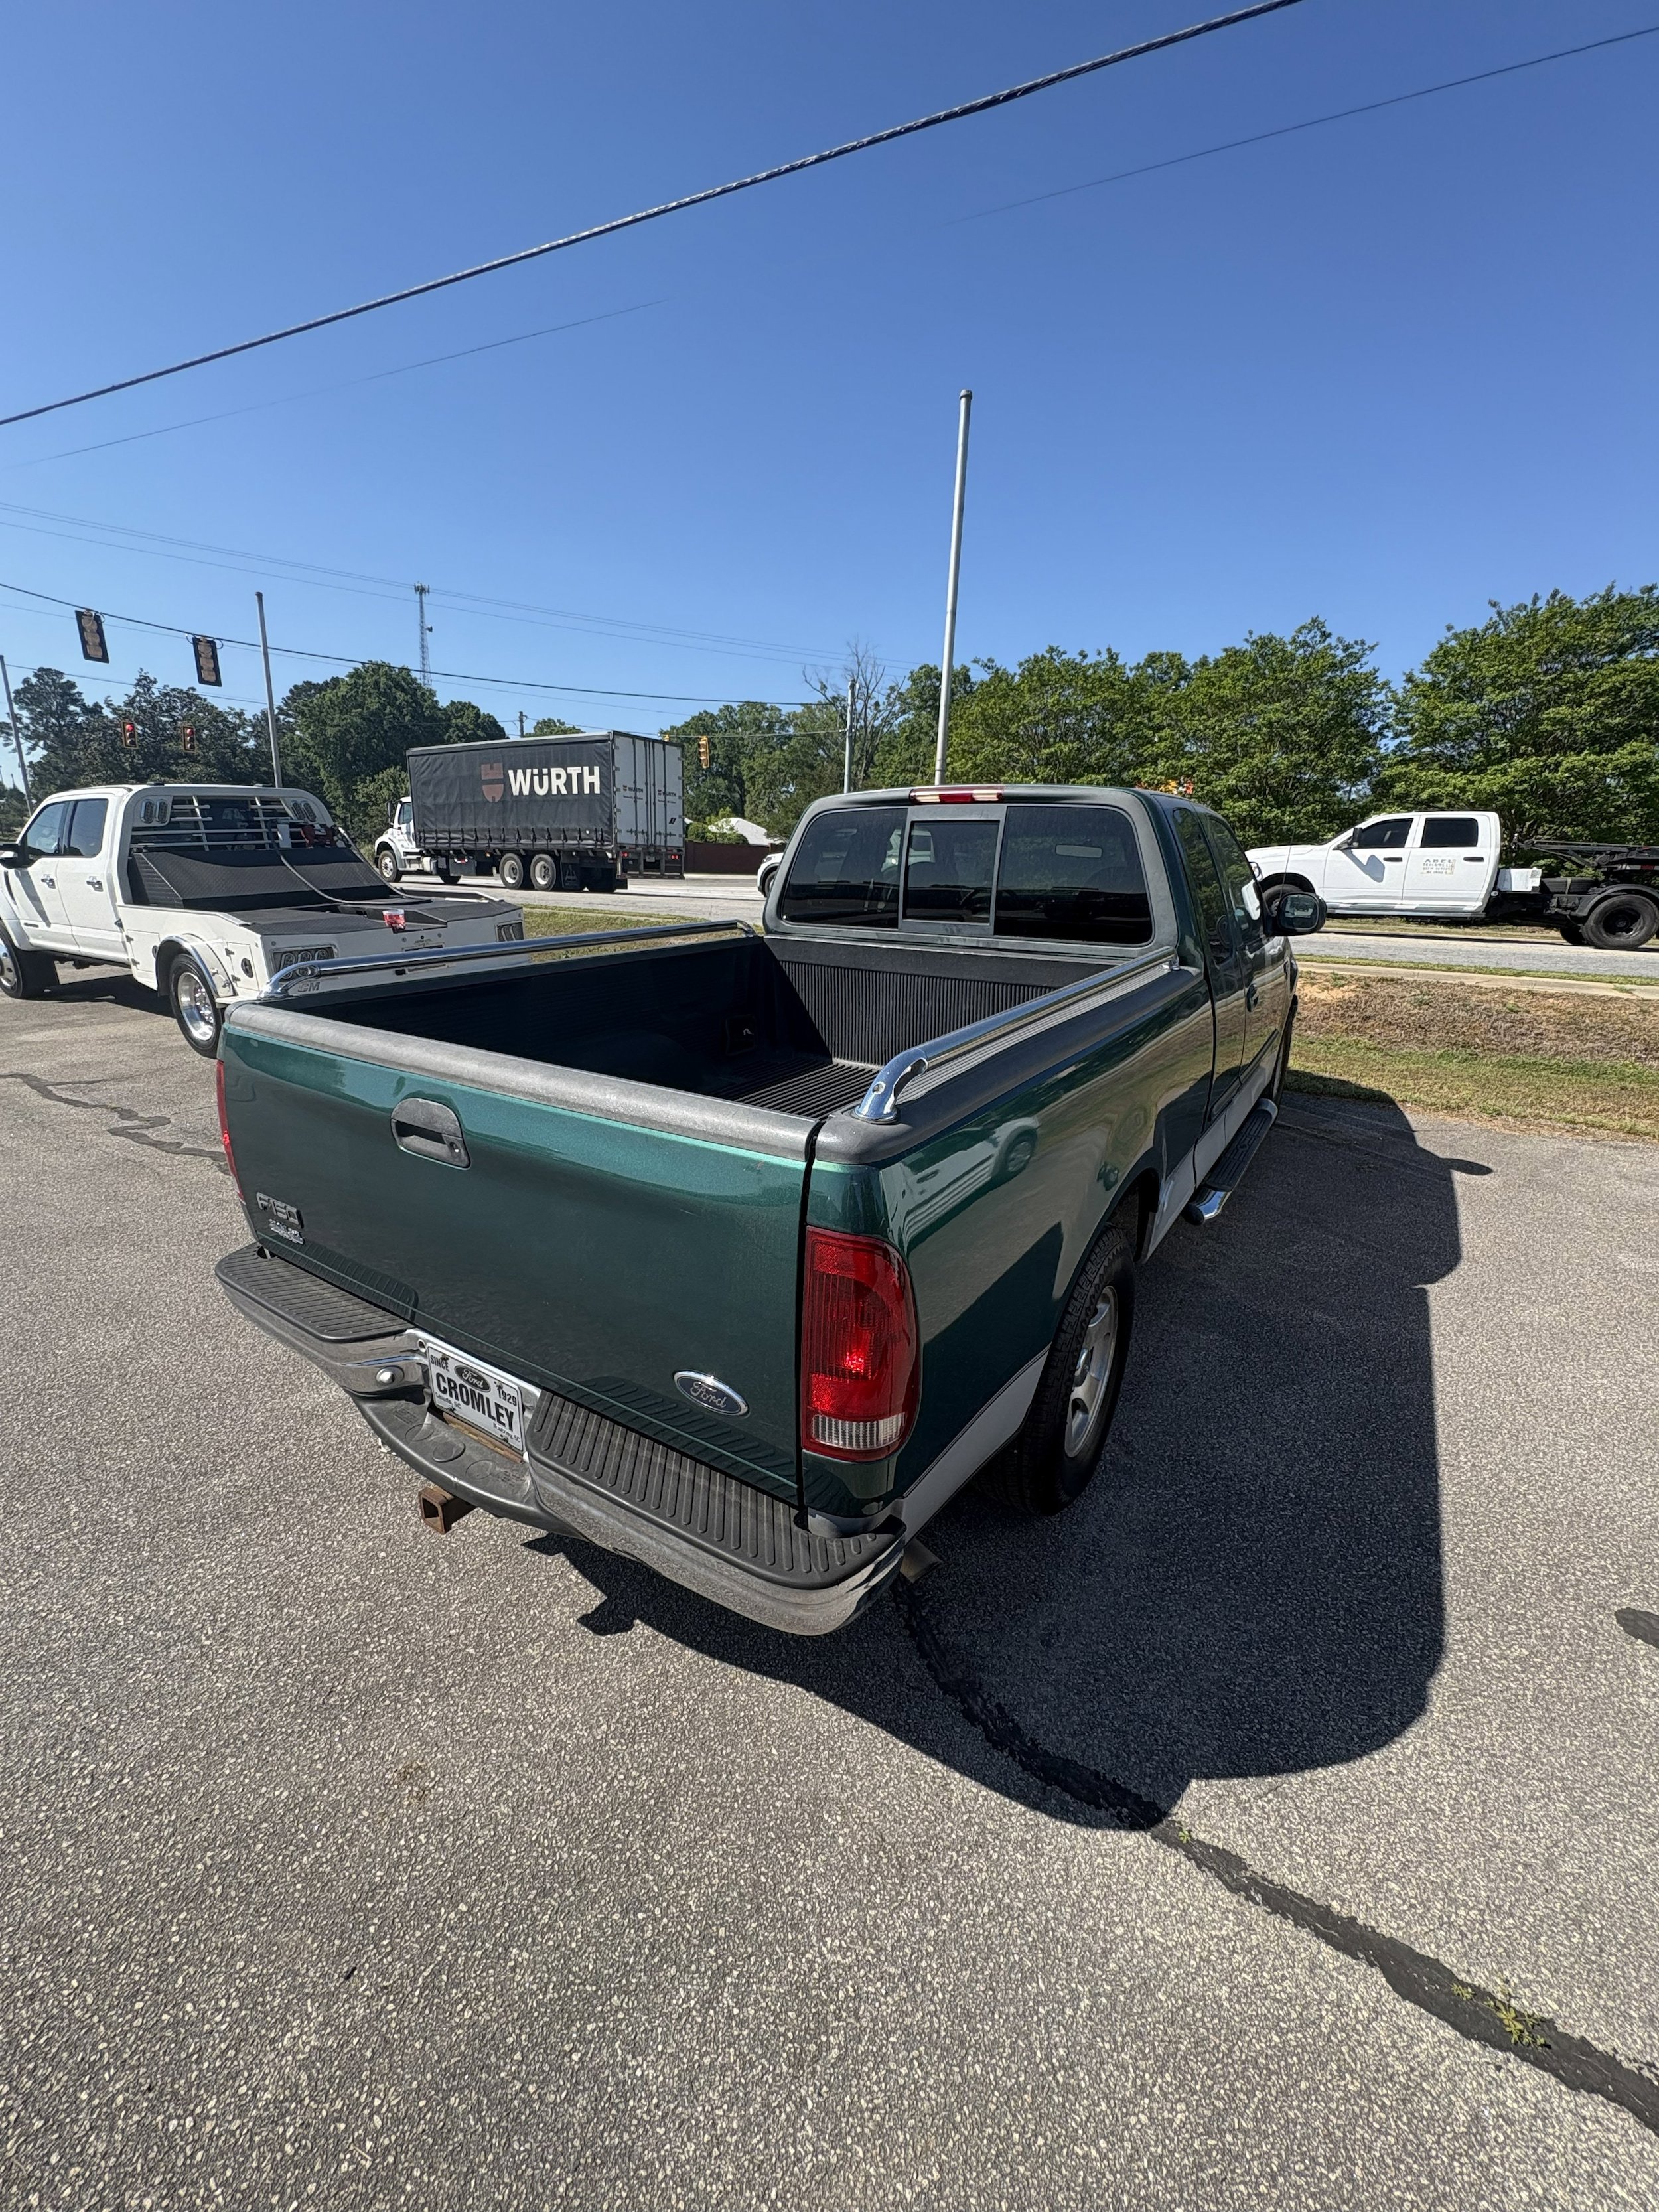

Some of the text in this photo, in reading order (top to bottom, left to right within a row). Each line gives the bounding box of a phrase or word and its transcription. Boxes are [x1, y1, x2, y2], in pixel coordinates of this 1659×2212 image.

[508, 766, 600, 796] WÜRTH
[430, 1355, 517, 1406] SINCE 1929
[462, 1368, 483, 1388] Ford
[436, 1372, 514, 1432] CROMLEY
[690, 1382, 727, 1408] Ford
